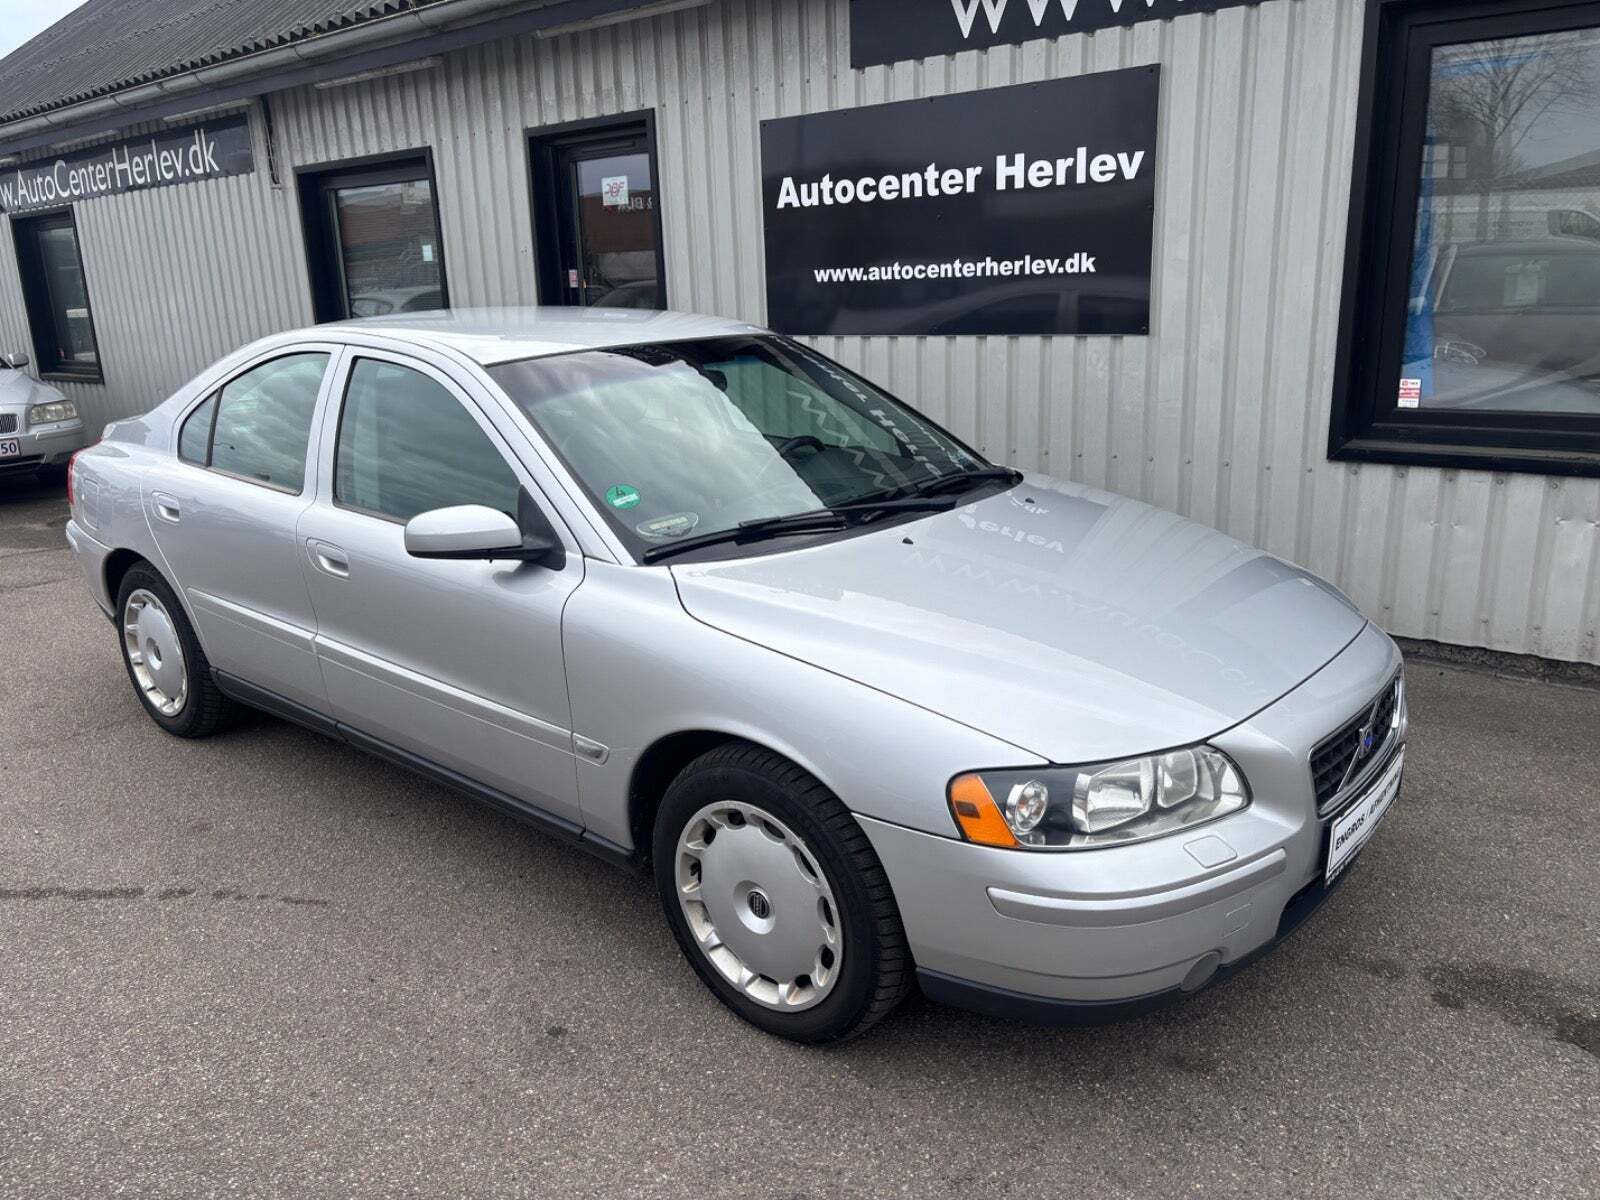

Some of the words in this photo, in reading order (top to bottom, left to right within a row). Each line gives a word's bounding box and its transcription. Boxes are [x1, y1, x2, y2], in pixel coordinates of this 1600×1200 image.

[777, 162, 983, 208] Autocenter
[995, 147, 1144, 191] Herlev
[814, 252, 1096, 283] www.autocenterherlev.dk
[1, 442, 17, 454] 50
